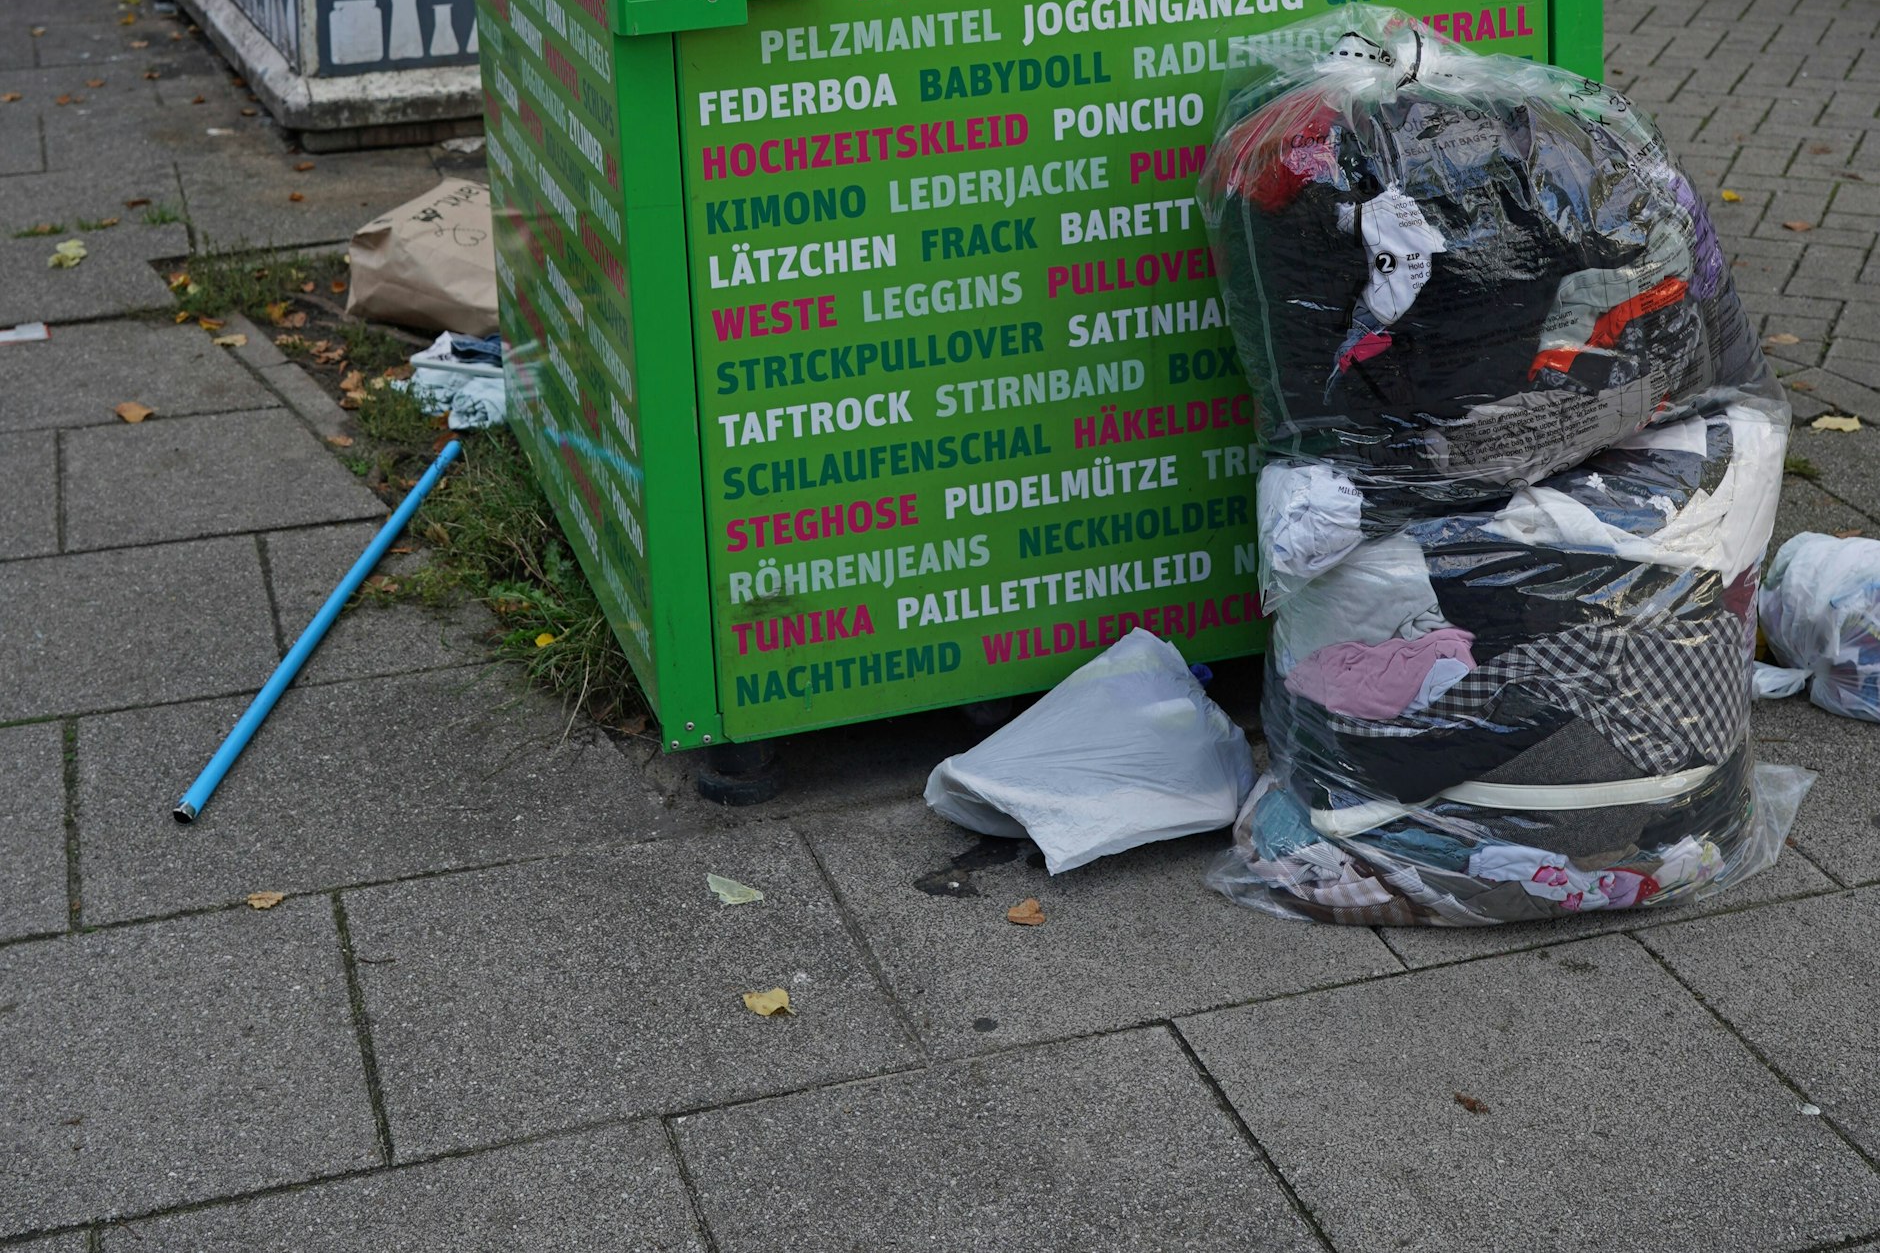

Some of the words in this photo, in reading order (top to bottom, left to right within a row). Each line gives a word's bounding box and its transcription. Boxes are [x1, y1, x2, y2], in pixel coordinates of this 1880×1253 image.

[568, 13, 587, 62] HIGH
[586, 32, 611, 88] HEELS
[700, 73, 897, 125] FEDERBOA
[919, 52, 1111, 102] BABYDOLL
[1133, 28, 1347, 79] RADLERHOS
[761, 9, 1001, 64] PELZMANTEL
[567, 105, 604, 181] ZYLINDER
[703, 113, 1029, 180] HOCHZEITSKLEID
[1053, 93, 1204, 141] PONCHO
[706, 184, 867, 235] KIMONO
[889, 158, 1109, 213] LEDERJACKE
[1130, 145, 1207, 185] PUM
[709, 234, 896, 289] LÄTZCHEN
[921, 217, 1037, 262] FRACK
[1061, 199, 1195, 246] BARETT
[1378, 254, 1393, 273] 2
[1406, 252, 1420, 261] ZIP
[1408, 262, 1425, 271] Hold
[712, 295, 837, 341] WESTE
[862, 271, 1022, 323] LEGGINS
[1048, 247, 1218, 298] PULLOVE
[717, 321, 1044, 395] STRICKPULLOVER
[1068, 301, 1232, 348] SATINHA
[718, 390, 912, 448] TAFTROCK
[936, 359, 1145, 417] STIRNBAND
[1169, 346, 1246, 384] BOX
[723, 424, 1051, 500] SCHLAUFENSCHAL
[1073, 393, 1250, 449] HÄKELDEC
[610, 476, 644, 565] PONCHO
[726, 494, 919, 552] STEGHOSE
[945, 455, 1178, 520] PUDELMÜTZE
[1203, 443, 1259, 480] TRE
[729, 534, 990, 605] RÖHRENJEANS
[1019, 495, 1249, 559] NECKHOLDER
[731, 604, 874, 656] TUNIKA
[898, 550, 1212, 630] PAILLETTENKLEID
[736, 641, 961, 707] NACHTHEMD
[983, 592, 1264, 666] WILDLEDERJACK
